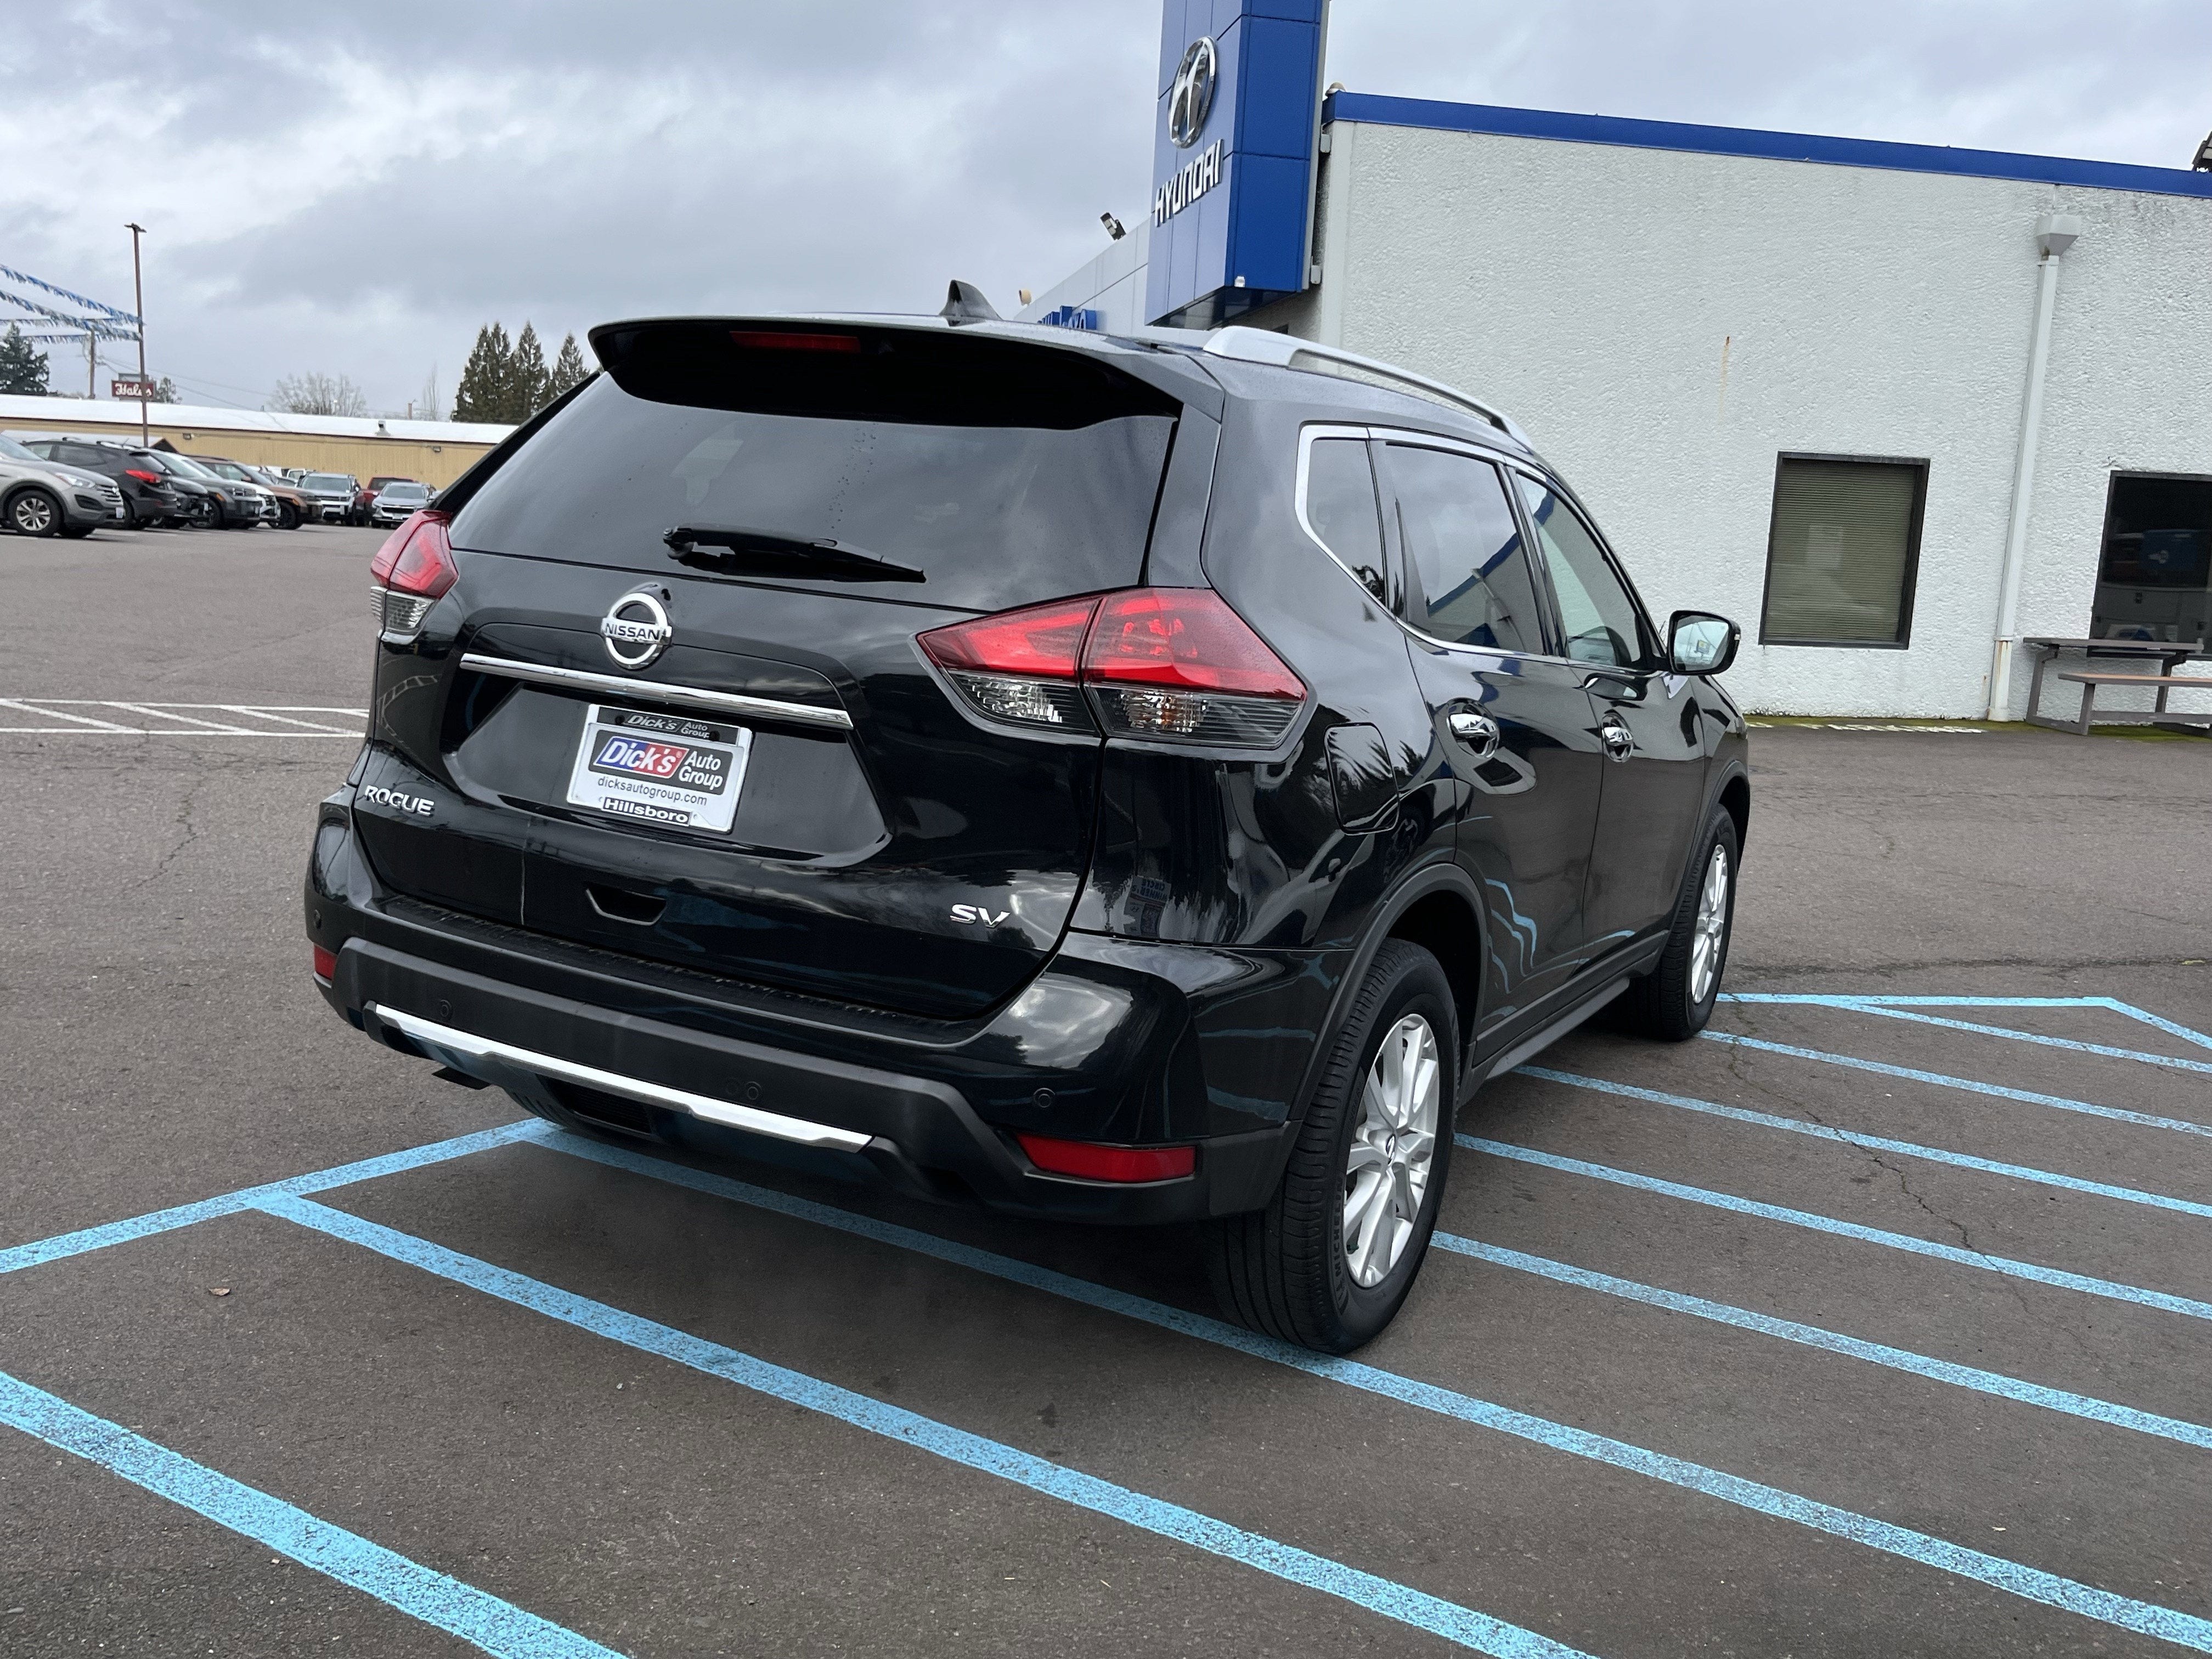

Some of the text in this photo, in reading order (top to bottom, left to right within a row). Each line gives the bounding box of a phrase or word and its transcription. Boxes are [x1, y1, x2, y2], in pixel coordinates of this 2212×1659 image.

[1155, 139, 1221, 227] HYUNDAI
[606, 623, 660, 640] NISSAN
[628, 715, 678, 730] Dick's
[681, 727, 710, 738] Group
[685, 722, 708, 731] Auto
[602, 741, 676, 774] Dick's
[684, 751, 721, 771] Auto
[679, 766, 723, 791] Group
[365, 785, 435, 817] ROGUE
[597, 777, 707, 806] dicksautogroup.com
[604, 798, 688, 823] Hillsboro
[950, 904, 1011, 928] SV
